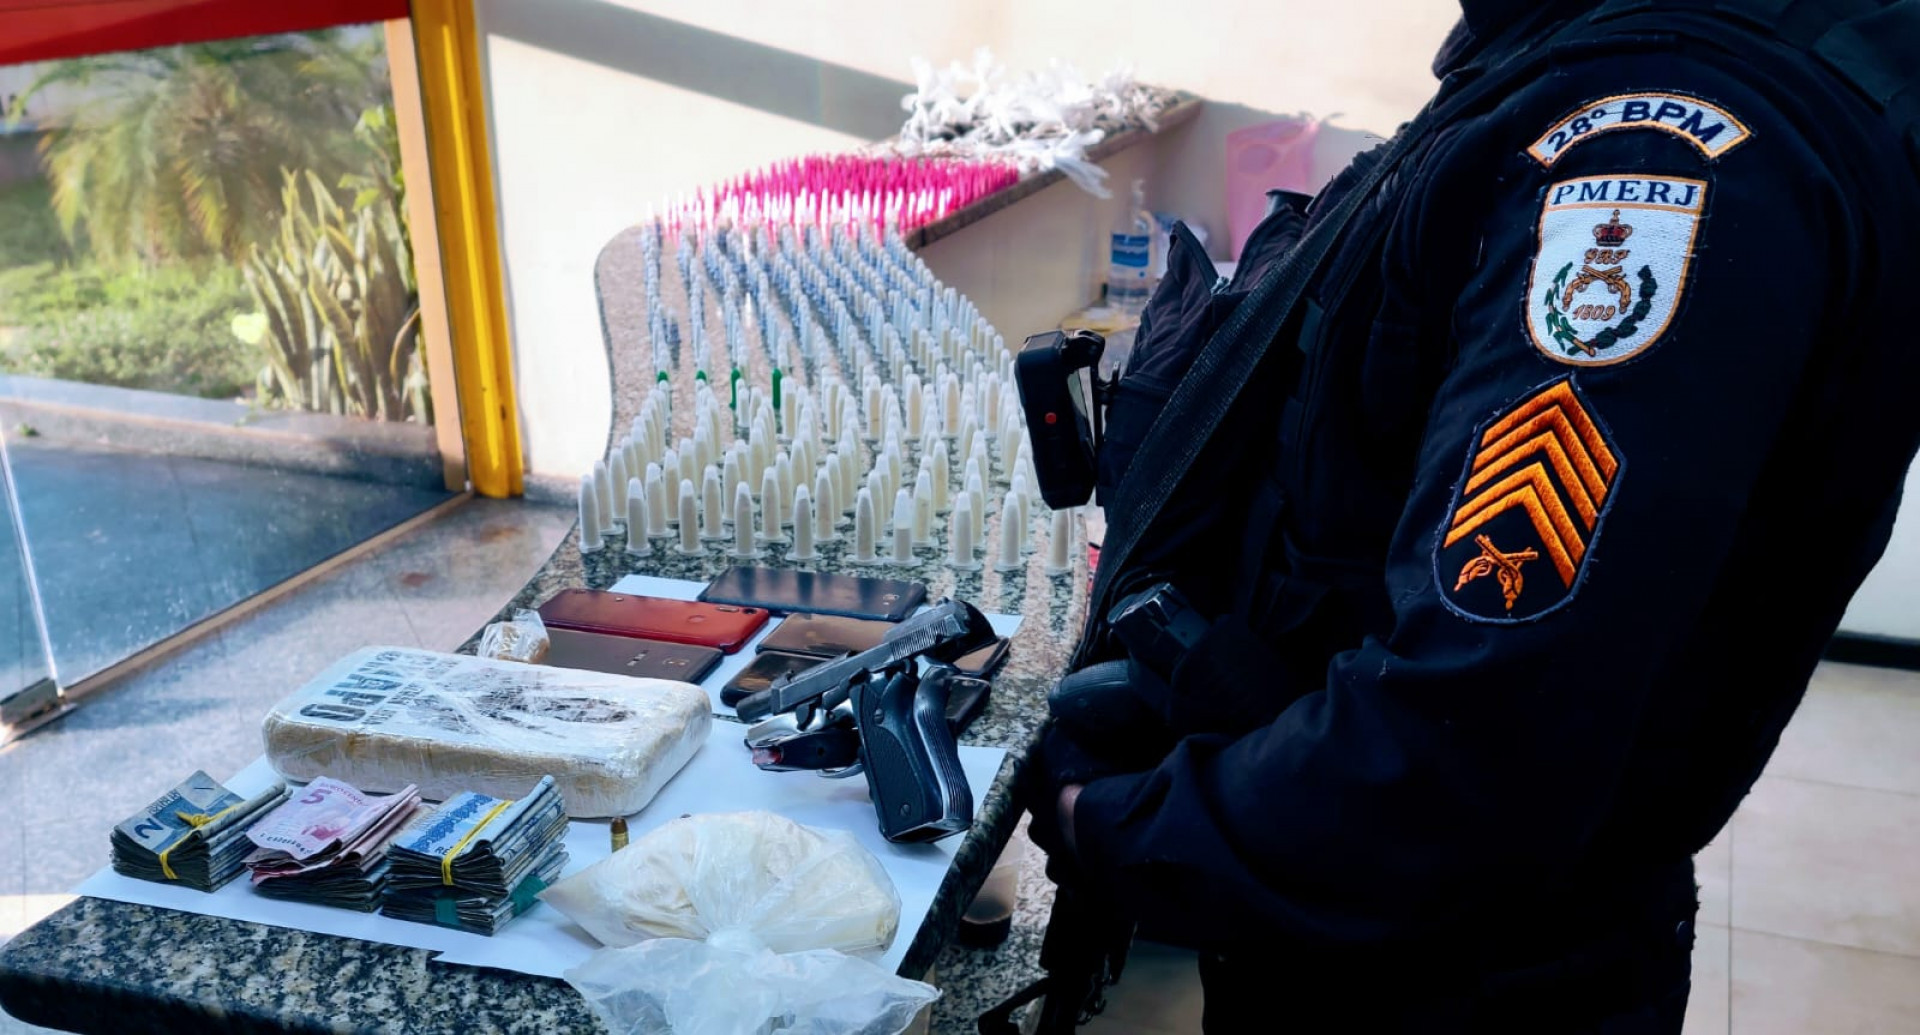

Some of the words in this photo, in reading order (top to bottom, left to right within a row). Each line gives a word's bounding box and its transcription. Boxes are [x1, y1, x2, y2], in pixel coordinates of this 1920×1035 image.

[1621, 101, 1726, 144] BPM
[1552, 179, 1699, 206] PMERJ
[1572, 303, 1616, 321] 1809
[300, 788, 332, 804] 5
[134, 817, 164, 839] 2
